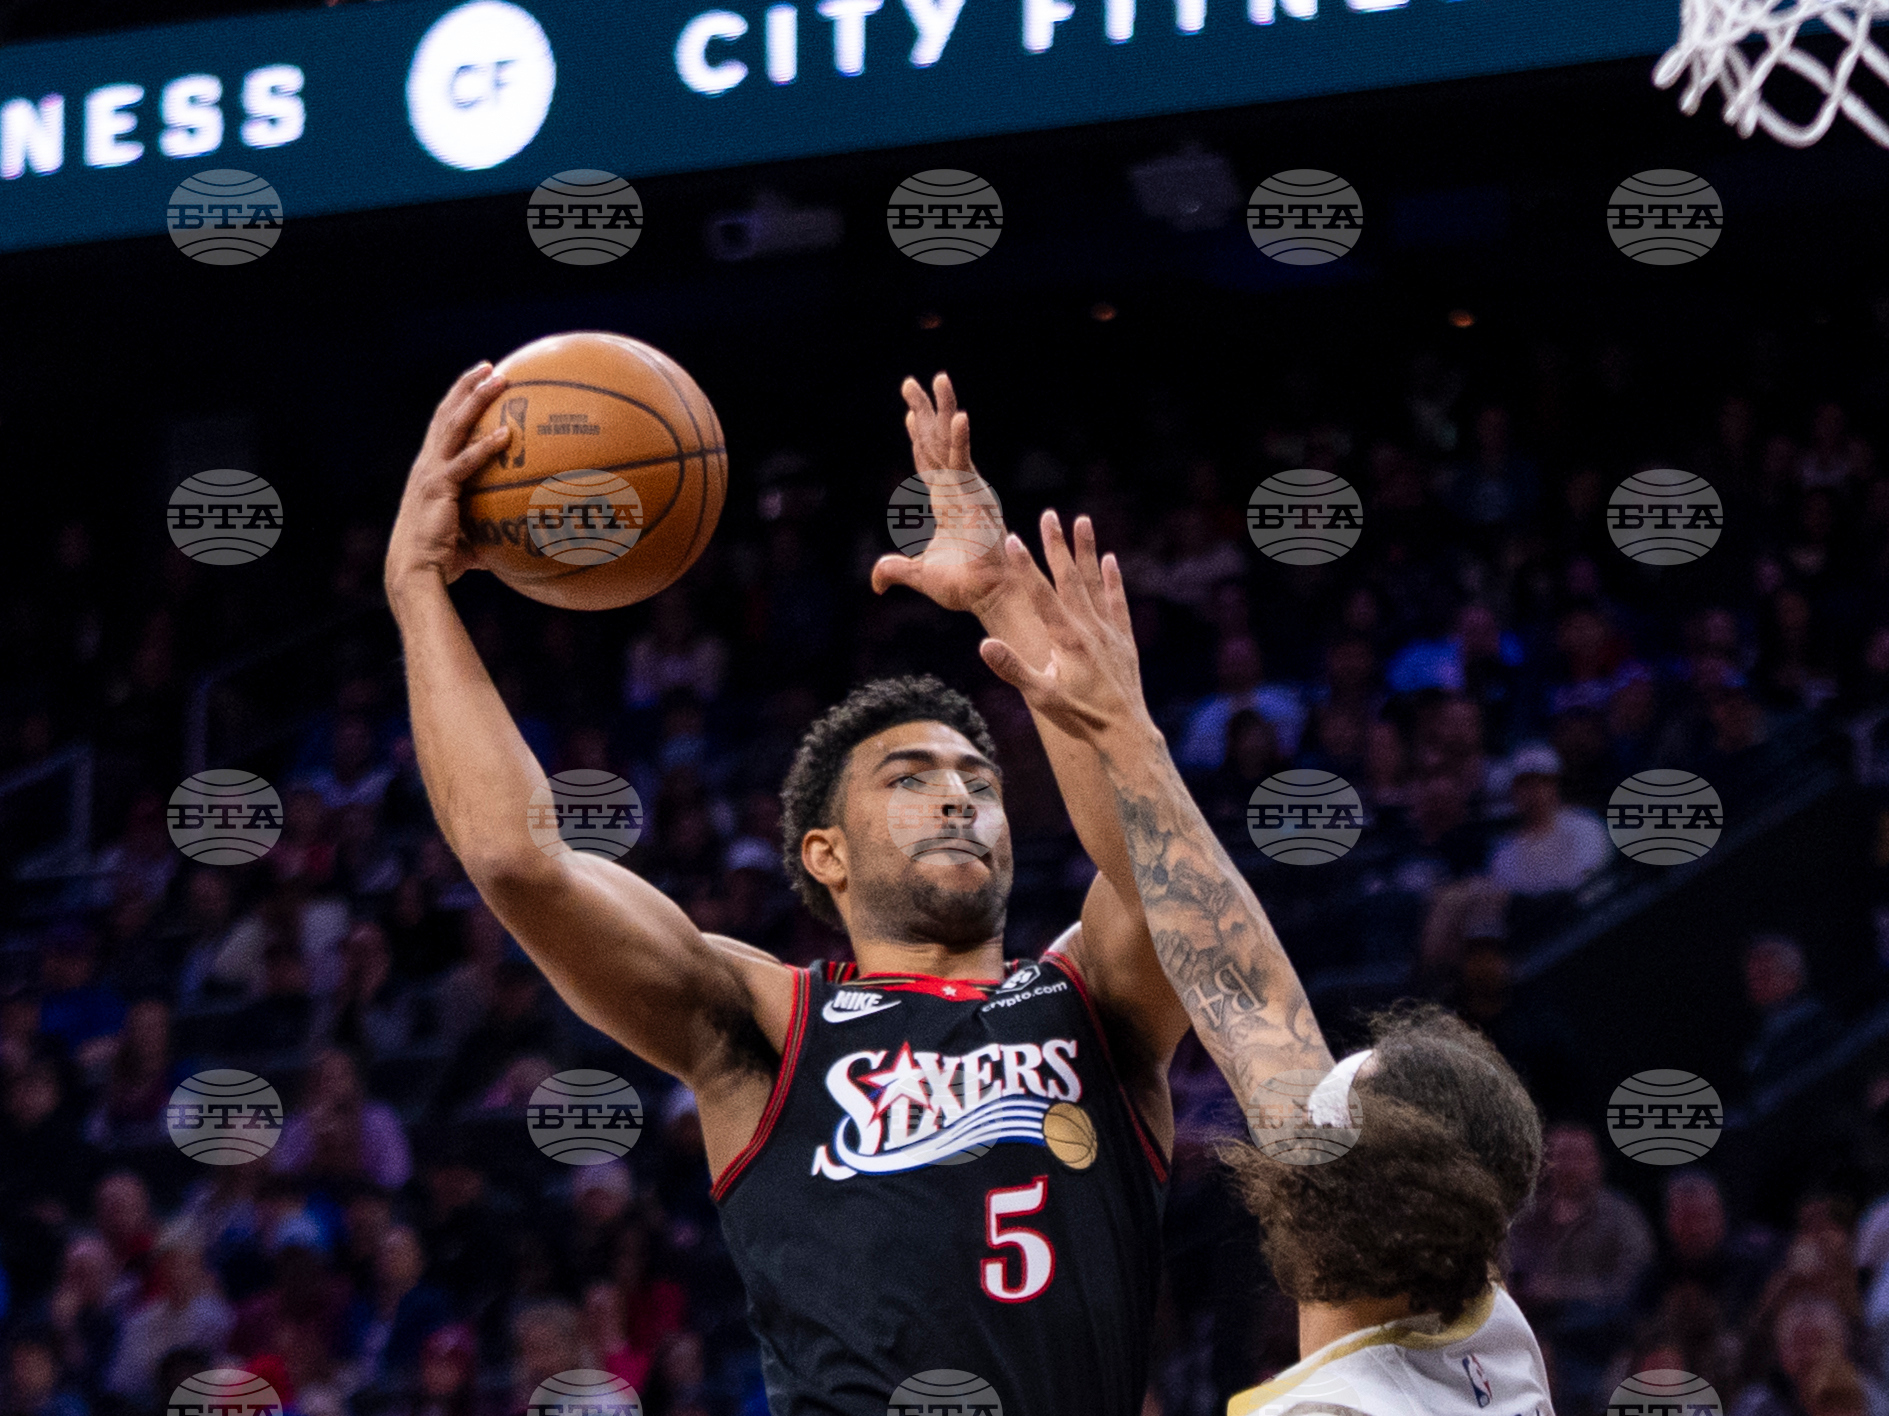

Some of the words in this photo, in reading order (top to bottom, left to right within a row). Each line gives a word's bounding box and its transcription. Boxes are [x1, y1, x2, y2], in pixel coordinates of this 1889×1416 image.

[449, 58, 518, 110] CF
[675, 0, 966, 97] CITY
[0, 63, 306, 180] NESS
[833, 990, 882, 1011] NIKE
[981, 980, 1068, 1013] crypto.com
[980, 1174, 1056, 1304] 5
